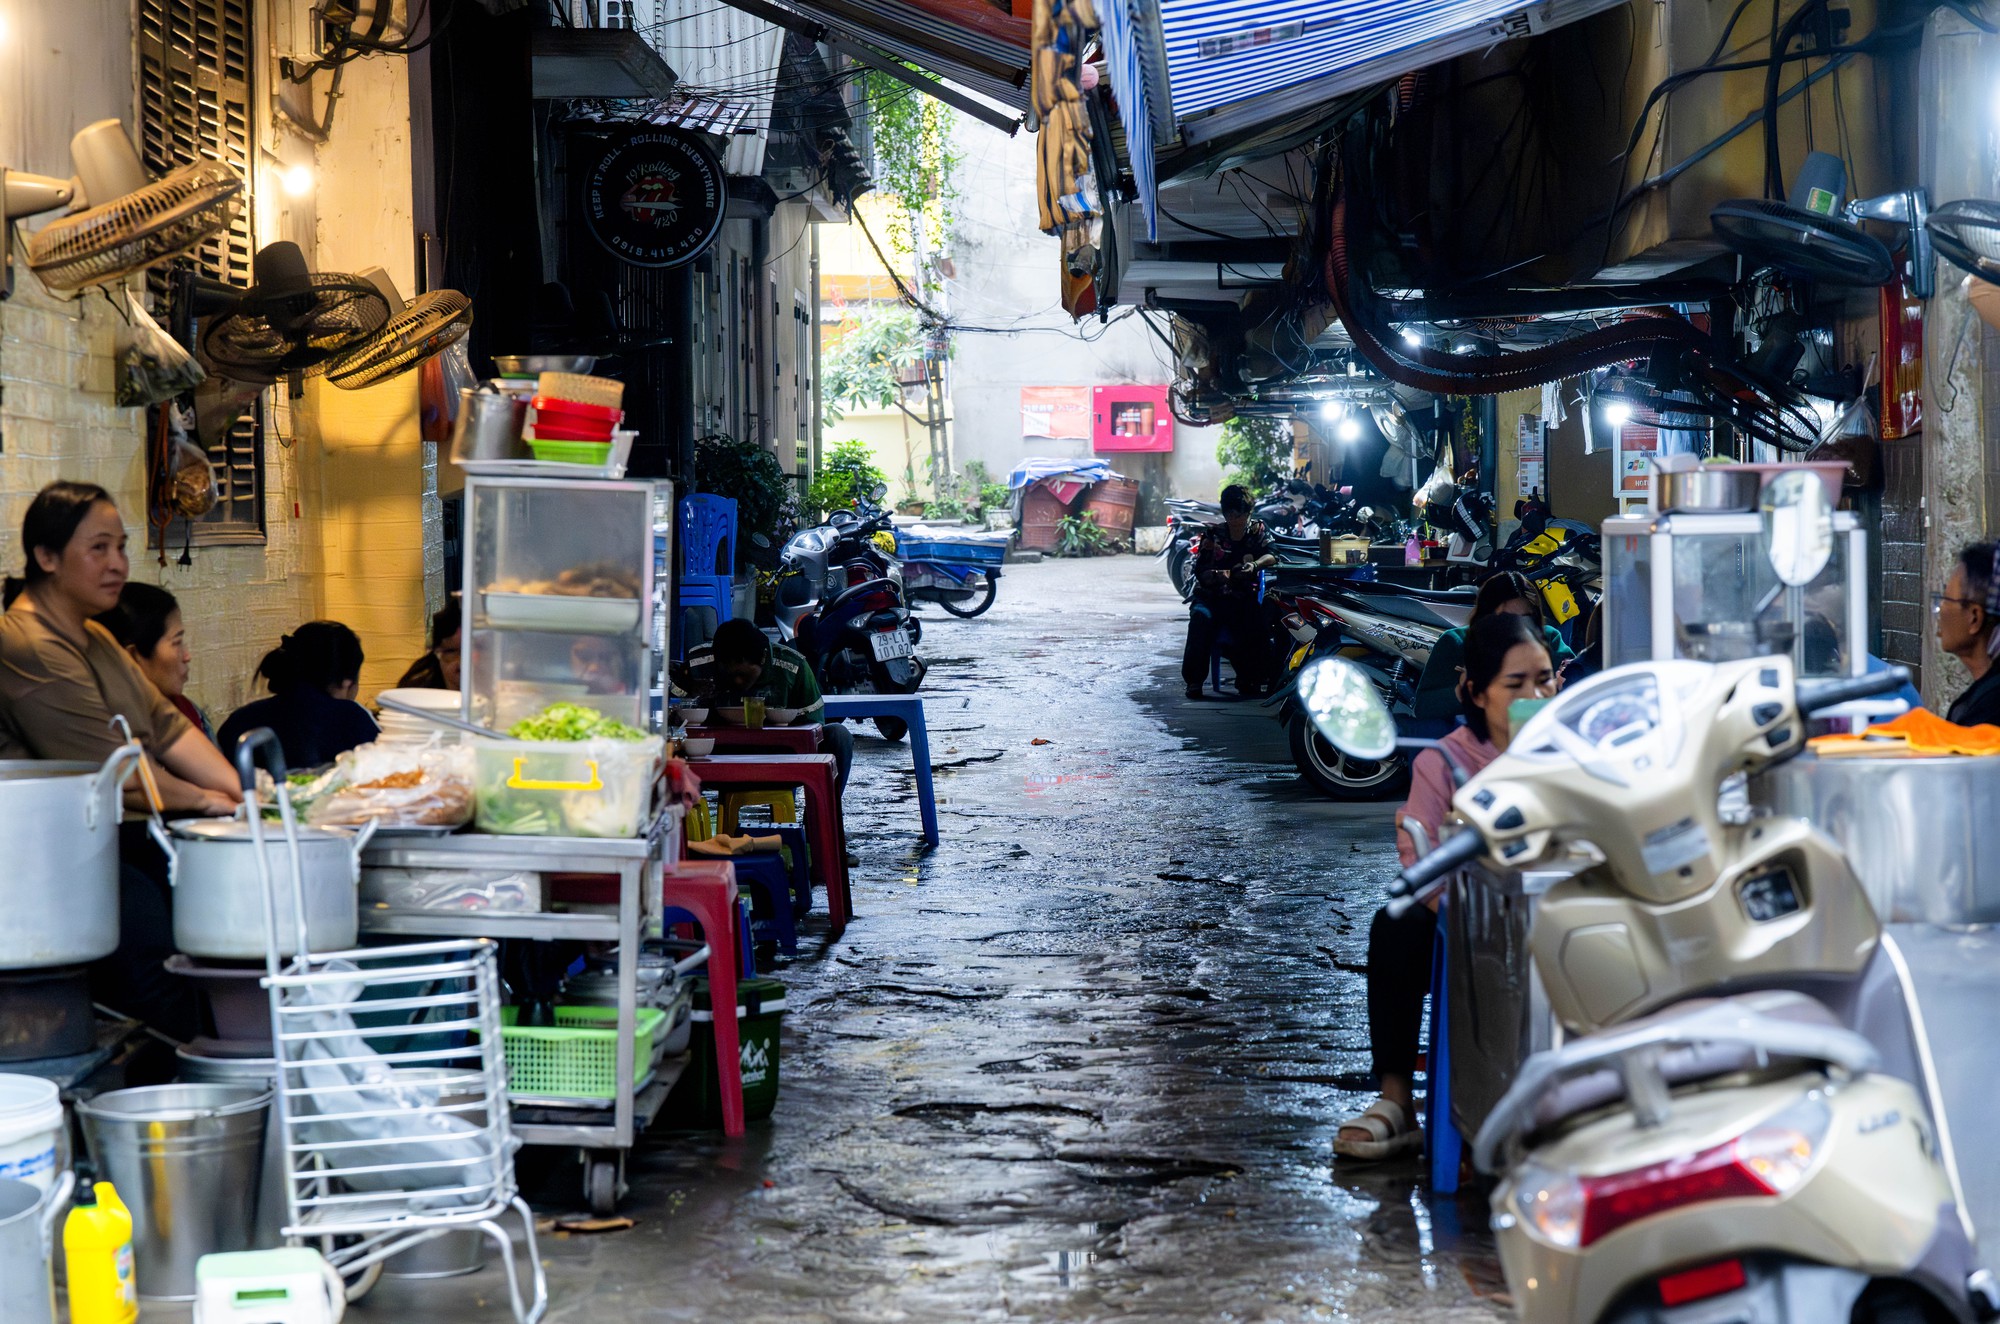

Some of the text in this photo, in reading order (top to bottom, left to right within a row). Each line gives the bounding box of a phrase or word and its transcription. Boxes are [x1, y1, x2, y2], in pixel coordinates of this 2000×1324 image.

[630, 134, 679, 147] ROLLING
[598, 148, 621, 172] ROLL
[592, 174, 603, 186] IT
[625, 160, 681, 185] 19 Rolling
[680, 143, 715, 209] EVERYTHING
[592, 190, 605, 219] KEEP
[654, 210, 678, 229] 420
[612, 227, 703, 258] 0918.419.420
[876, 631, 904, 647] 29-L1
[877, 643, 911, 659] 101.82
